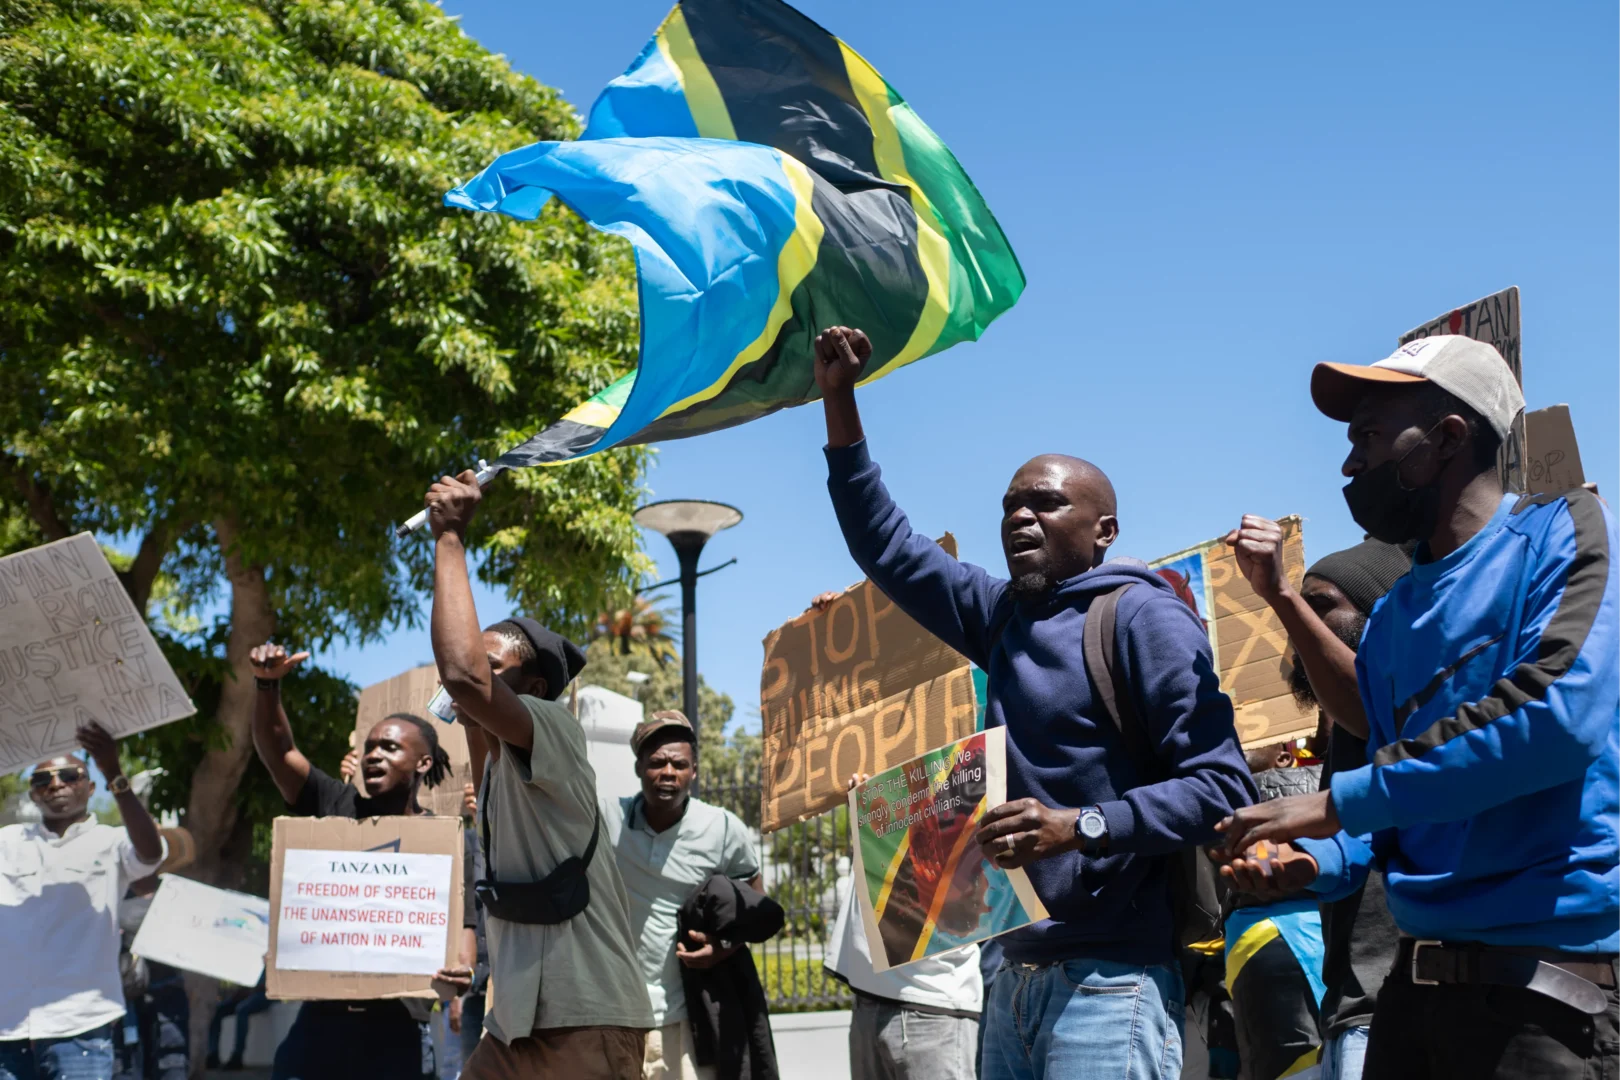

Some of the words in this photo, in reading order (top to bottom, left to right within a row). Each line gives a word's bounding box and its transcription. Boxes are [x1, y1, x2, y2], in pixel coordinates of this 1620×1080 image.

[0, 615, 147, 686] USTICE
[97, 656, 154, 698] IN
[858, 803, 889, 827] strongly
[891, 788, 932, 812] condemn
[933, 779, 950, 794] the
[952, 767, 982, 787] killing
[862, 783, 884, 805] STOP
[887, 773, 908, 793] THE
[909, 757, 951, 784] KILLING
[953, 749, 971, 767] We
[875, 823, 884, 839] of
[885, 809, 923, 835] innocent
[923, 795, 964, 818] civilians.
[329, 861, 408, 876] TANZANIA
[298, 882, 359, 897] FREEDOM
[364, 884, 379, 898] OF
[384, 885, 436, 901] SPEECH
[284, 906, 307, 920] THE
[311, 907, 404, 924] UNANSWERED
[408, 911, 446, 926] CRIES
[300, 931, 316, 945] OF
[321, 932, 369, 947] NATION
[373, 934, 386, 947] IN
[391, 935, 425, 949] PAIN.
